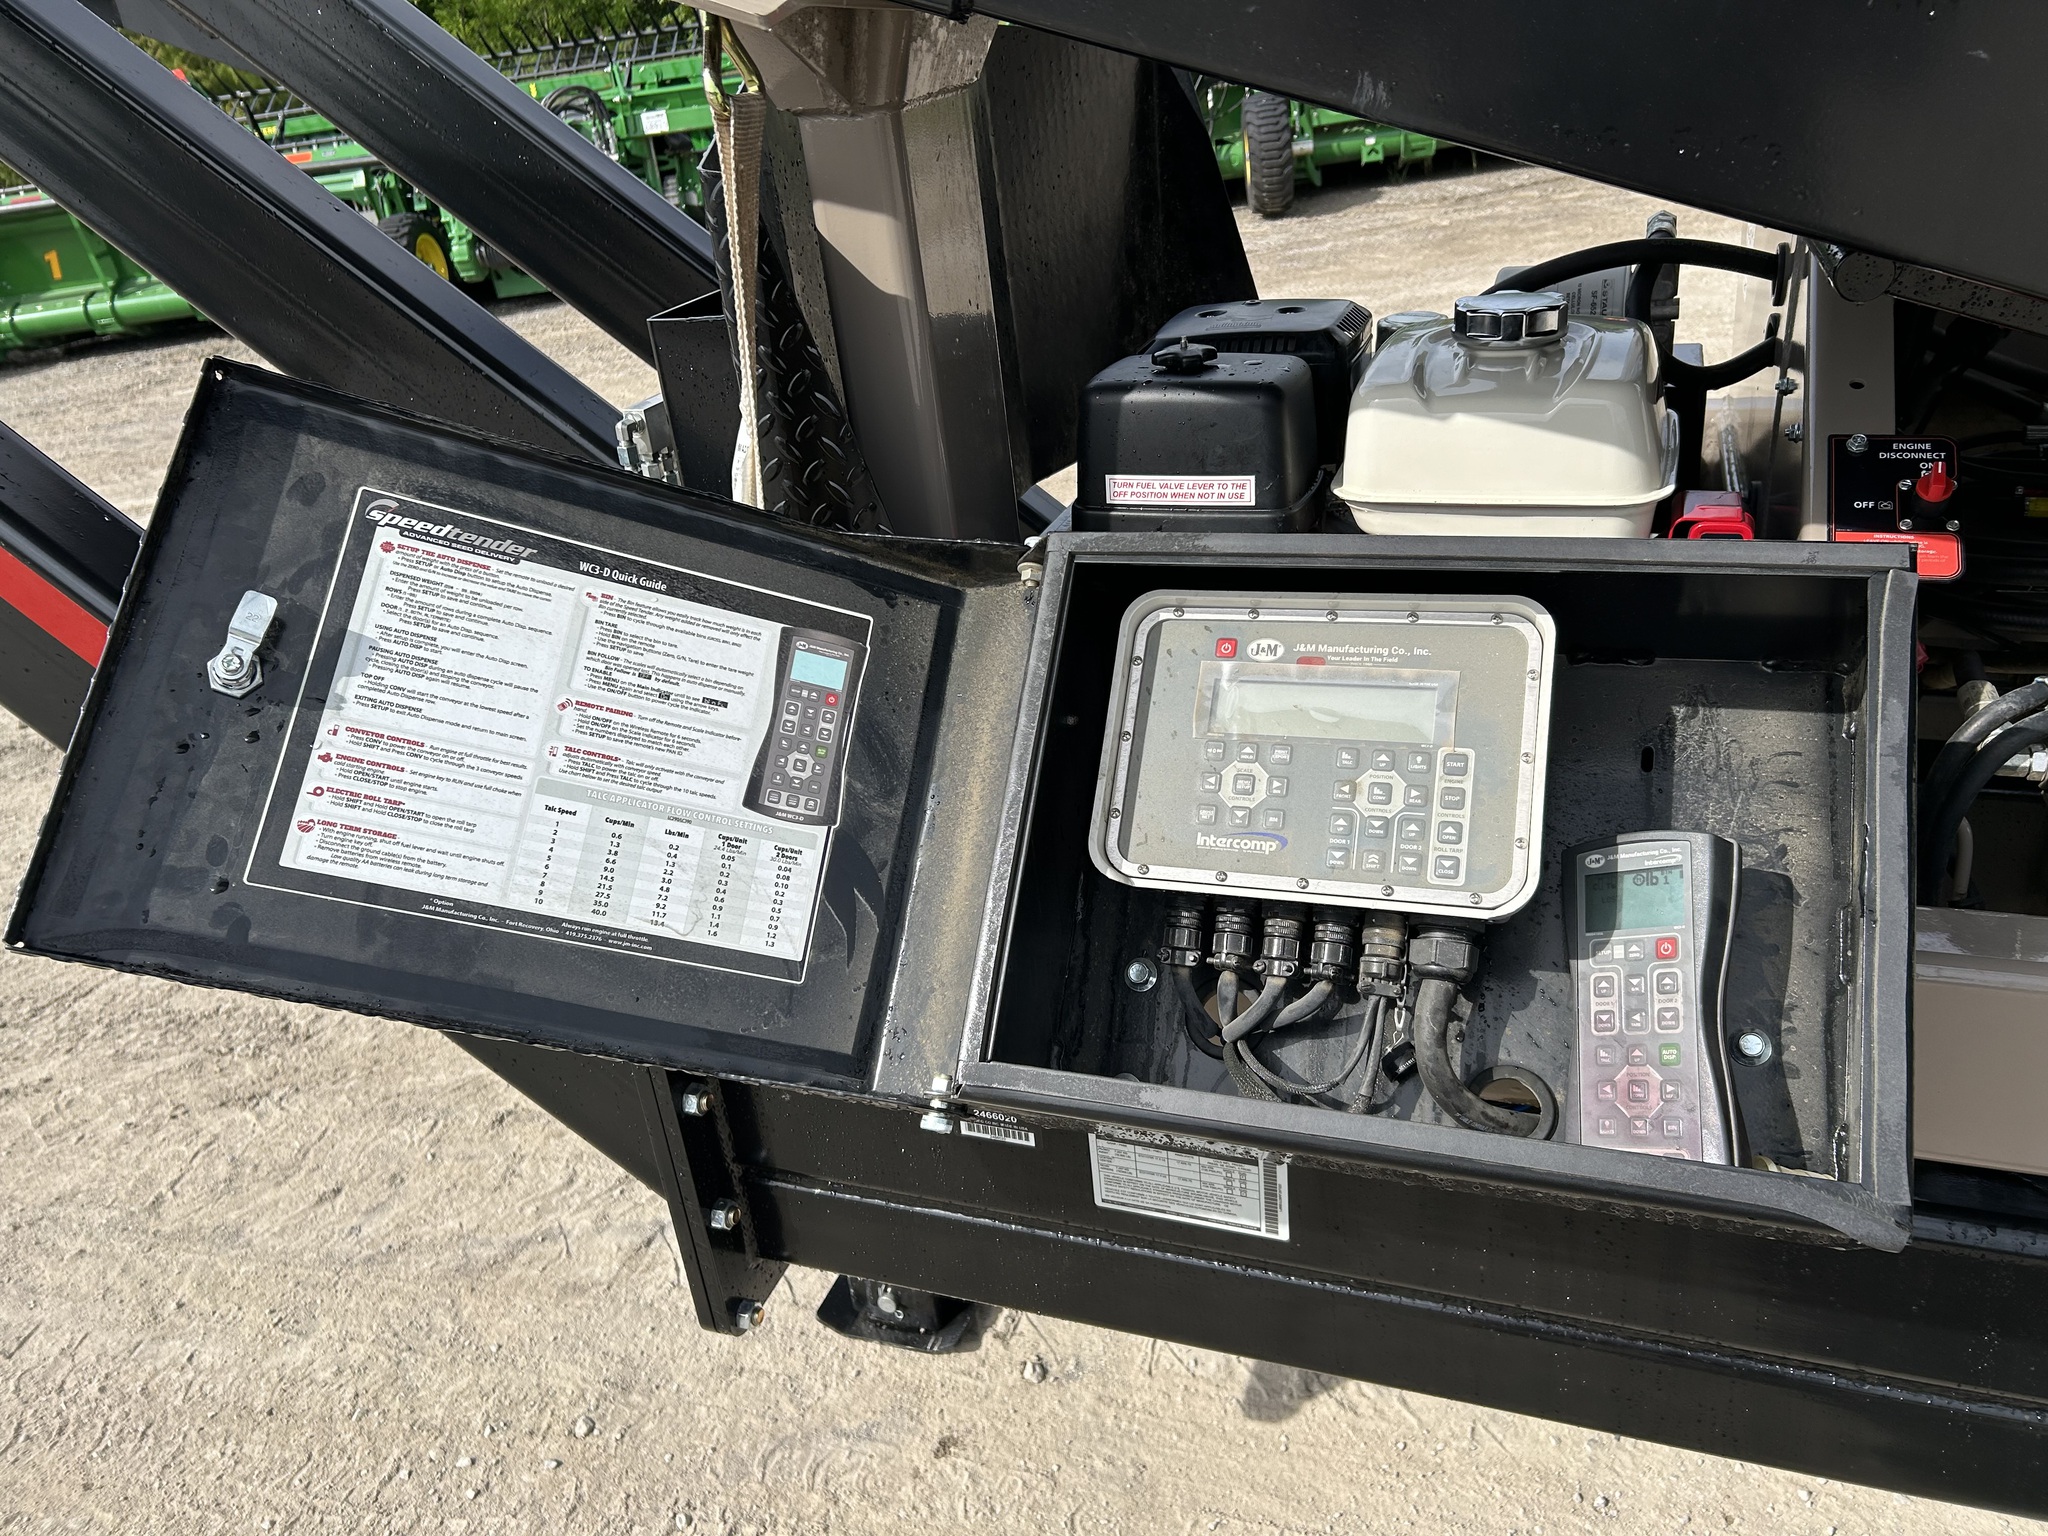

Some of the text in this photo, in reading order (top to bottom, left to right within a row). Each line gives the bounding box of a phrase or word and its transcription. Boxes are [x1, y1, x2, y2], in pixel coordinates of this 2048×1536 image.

[44, 250, 62, 280] 1
[402, 531, 516, 562] ADVANCED SEED DELIVERY
[397, 543, 492, 571] SETUP THE AUTO DISPENSE
[579, 561, 667, 592] WC3-D Quick Guide
[1250, 643, 1280, 657] J&M
[1294, 644, 1432, 656] J&M Manufacturing Co., Inc.
[575, 700, 634, 718] REMOTE PAIRING
[345, 726, 426, 748] CONVEYOR CONTROLS
[564, 745, 582, 754] TALC
[335, 753, 406, 773] ENGINE CONTROLS
[326, 786, 363, 799] ELECTRIC
[362, 794, 382, 803] ROLL
[545, 804, 578, 817] Talc Speed
[586, 790, 608, 801] TALC
[609, 794, 665, 813] APPLICATOR
[666, 806, 692, 818] FLOW
[692, 811, 733, 827] CONTROL
[733, 820, 774, 835] SETTINGS
[605, 817, 635, 828] Cups/Min
[316, 819, 398, 840] LONG TERM STORAGE
[664, 829, 690, 839] Lbs/Min
[718, 833, 748, 845] Cups/Unit
[1196, 832, 1277, 854] Intercomp
[726, 842, 742, 850] Door
[774, 844, 803, 856] Cups/Unit
[607, 849, 619, 857] 3.8
[720, 854, 736, 862] 0.05
[781, 853, 798, 862] Doors
[1620, 850, 1658, 858] Manufacturing
[600, 874, 615, 883] 14.5
[663, 868, 674, 877] 2.2
[597, 882, 613, 891] 21.5
[595, 891, 611, 900] 27.5
[657, 894, 669, 902] 7.2
[433, 898, 454, 907] Option
[593, 899, 609, 908] 35.0
[435, 906, 478, 920] Manufacturing
[591, 908, 607, 917] 40.0
[652, 910, 667, 919] 11.7
[518, 922, 544, 932] Recovery,
[561, 922, 581, 931] Always
[627, 934, 649, 943] throttle.
[565, 930, 603, 942] 419.375.2376
[608, 939, 653, 951] www.jm-inc.com
[974, 1110, 1017, 1123] 2466020
